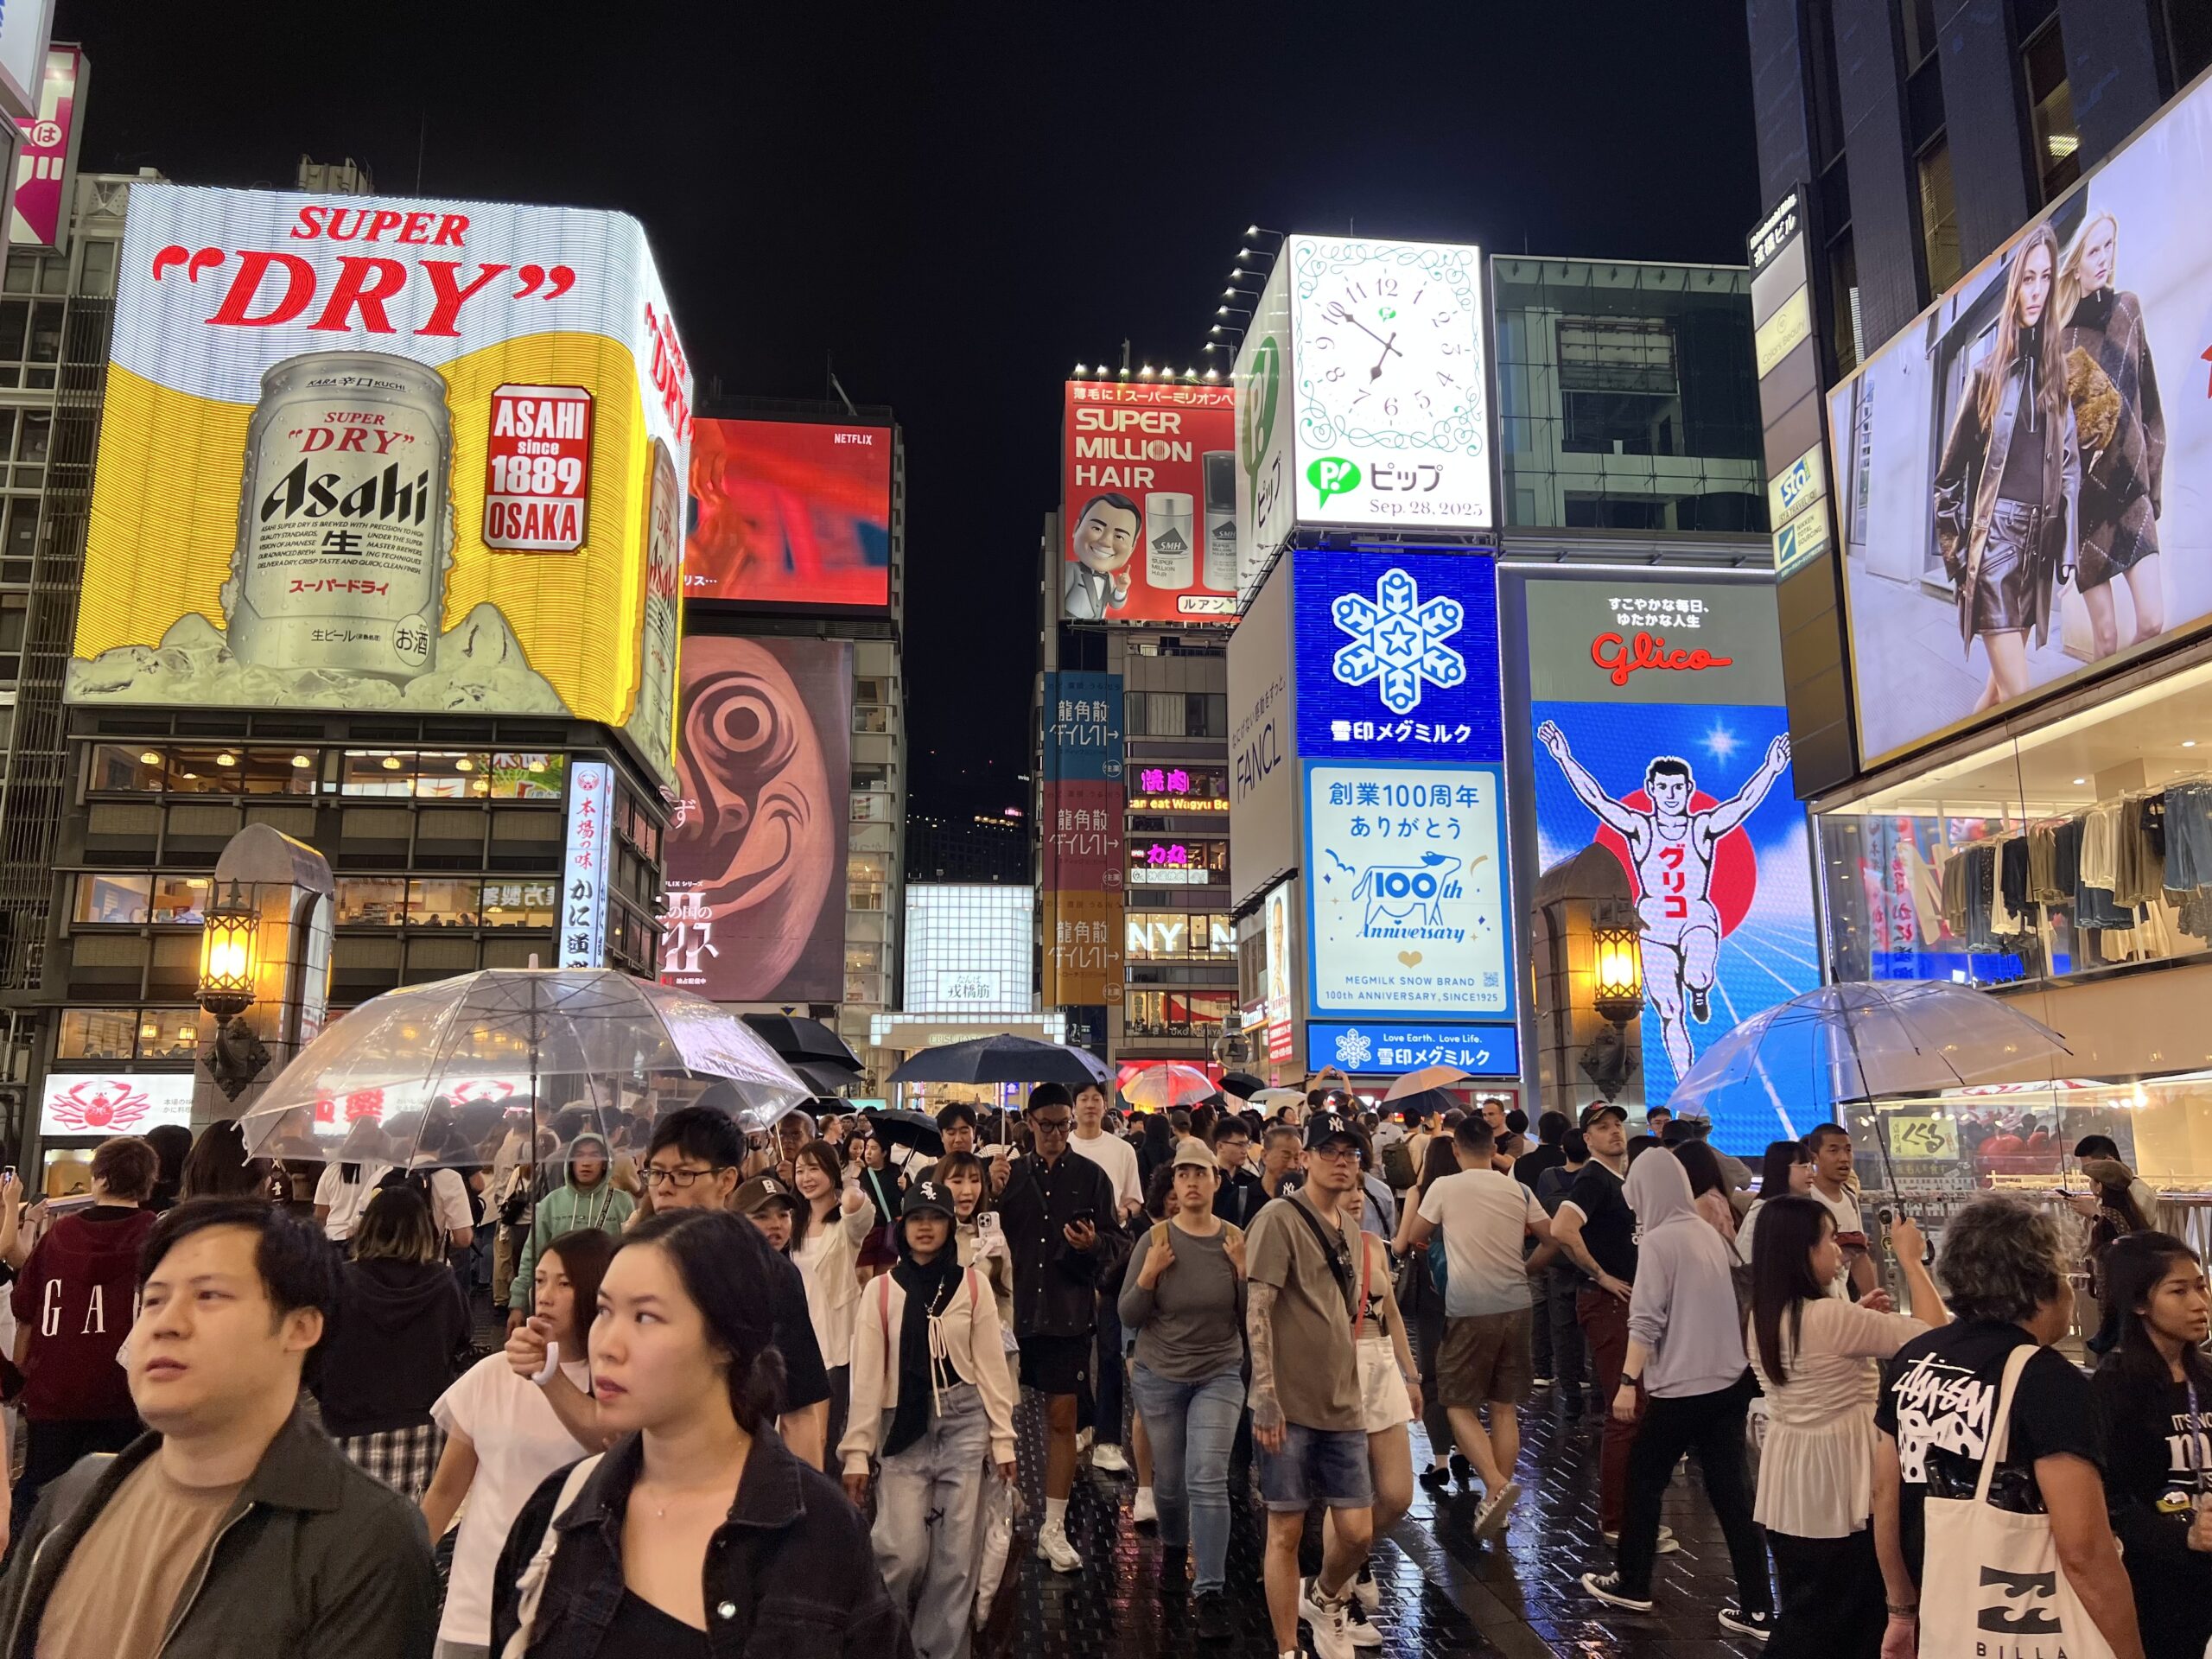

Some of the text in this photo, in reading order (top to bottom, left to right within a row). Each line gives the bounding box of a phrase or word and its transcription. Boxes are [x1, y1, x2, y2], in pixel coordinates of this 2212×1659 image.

[289, 206, 471, 248] SUPER
[1346, 283, 1367, 303] 11
[1376, 278, 1398, 296] 12
[1414, 289, 1423, 304] 1
[1321, 302, 1345, 326] 10
[1431, 312, 1450, 327] 2
[1315, 337, 1335, 350] 9
[1442, 343, 1461, 355] 3
[338, 377, 373, 387] 辛口
[374, 381, 405, 391] KUCHI
[1325, 367, 1345, 383] 8
[1436, 371, 1453, 386] 4
[1353, 389, 1372, 404] 7
[1414, 391, 1431, 410] 5
[1384, 397, 1398, 416] 6
[324, 412, 385, 425] SUPER
[494, 400, 585, 439] ASAHI
[1076, 408, 1181, 434] SUPER
[518, 439, 559, 454] since
[834, 434, 872, 445] NETFLIX
[1075, 436, 1192, 462] MILLION
[492, 455, 581, 495] 1889
[1075, 465, 1155, 489] HAIR
[1370, 462, 1443, 492] ピップ
[261, 457, 429, 527] Asahi
[1370, 499, 1406, 517] Sep.
[1440, 502, 1483, 516] 2025
[370, 523, 403, 533] PRECISION
[489, 502, 577, 541] OSAKA
[1797, 524, 1812, 538] TOTAL
[321, 530, 363, 556] 生
[366, 542, 396, 550] MASTER
[1160, 541, 1181, 550] SMH
[381, 553, 422, 565] TECHNIQUES
[383, 562, 404, 570] CLEAN
[289, 580, 389, 595] スーパードライ
[1184, 599, 1224, 610] ルアン
[1617, 613, 1700, 628] ゆたかな人生
[397, 628, 429, 656] お酒
[1058, 700, 1109, 722] 龍角散
[1331, 720, 1471, 744] 雪印メグミルク
[1237, 718, 1281, 804] FANCL
[1328, 781, 1480, 808] 創業100周年
[1150, 799, 1170, 809] eat
[1173, 799, 1211, 810] Wagyu
[1058, 809, 1109, 831] 龍角散
[1351, 817, 1461, 840] ありがとう
[575, 798, 596, 870] 本場の味
[1147, 843, 1186, 863] 力丸
[1658, 843, 1687, 918] グリコ
[1057, 920, 1109, 944] 龍角散
[1357, 922, 1465, 944] Anniversary
[957, 976, 982, 984] なんば
[1345, 976, 1475, 986] MEGMILK SNOW BRAND
[948, 984, 990, 999] 戎橋筋
[1325, 991, 1353, 1000] 100th
[1383, 1033, 1482, 1043] Love Earth. Love Life.
[1377, 1046, 1490, 1066] 雪印メグミルク
